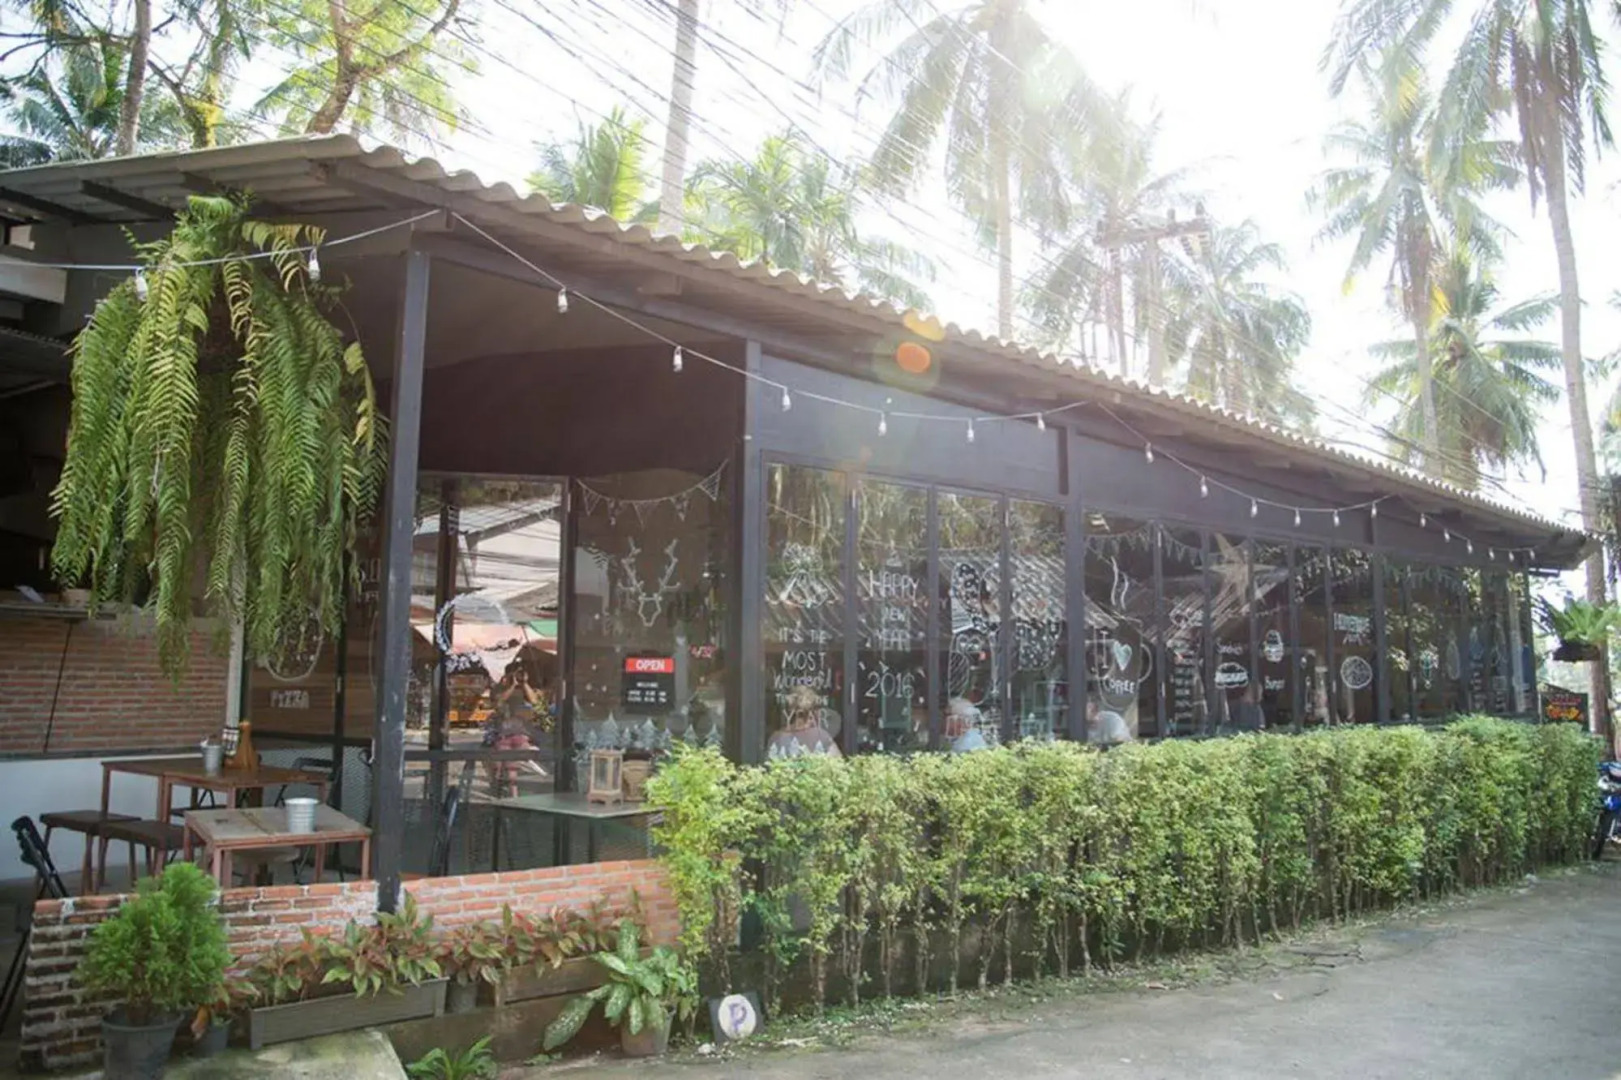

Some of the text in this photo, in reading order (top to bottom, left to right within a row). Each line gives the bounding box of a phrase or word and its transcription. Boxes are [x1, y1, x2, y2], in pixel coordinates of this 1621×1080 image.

[869, 569, 919, 602] HAPPY
[635, 658, 665, 671] OPEN
[782, 650, 826, 671] MOST
[864, 669, 916, 699] 2016
[728, 1002, 747, 1033] P
